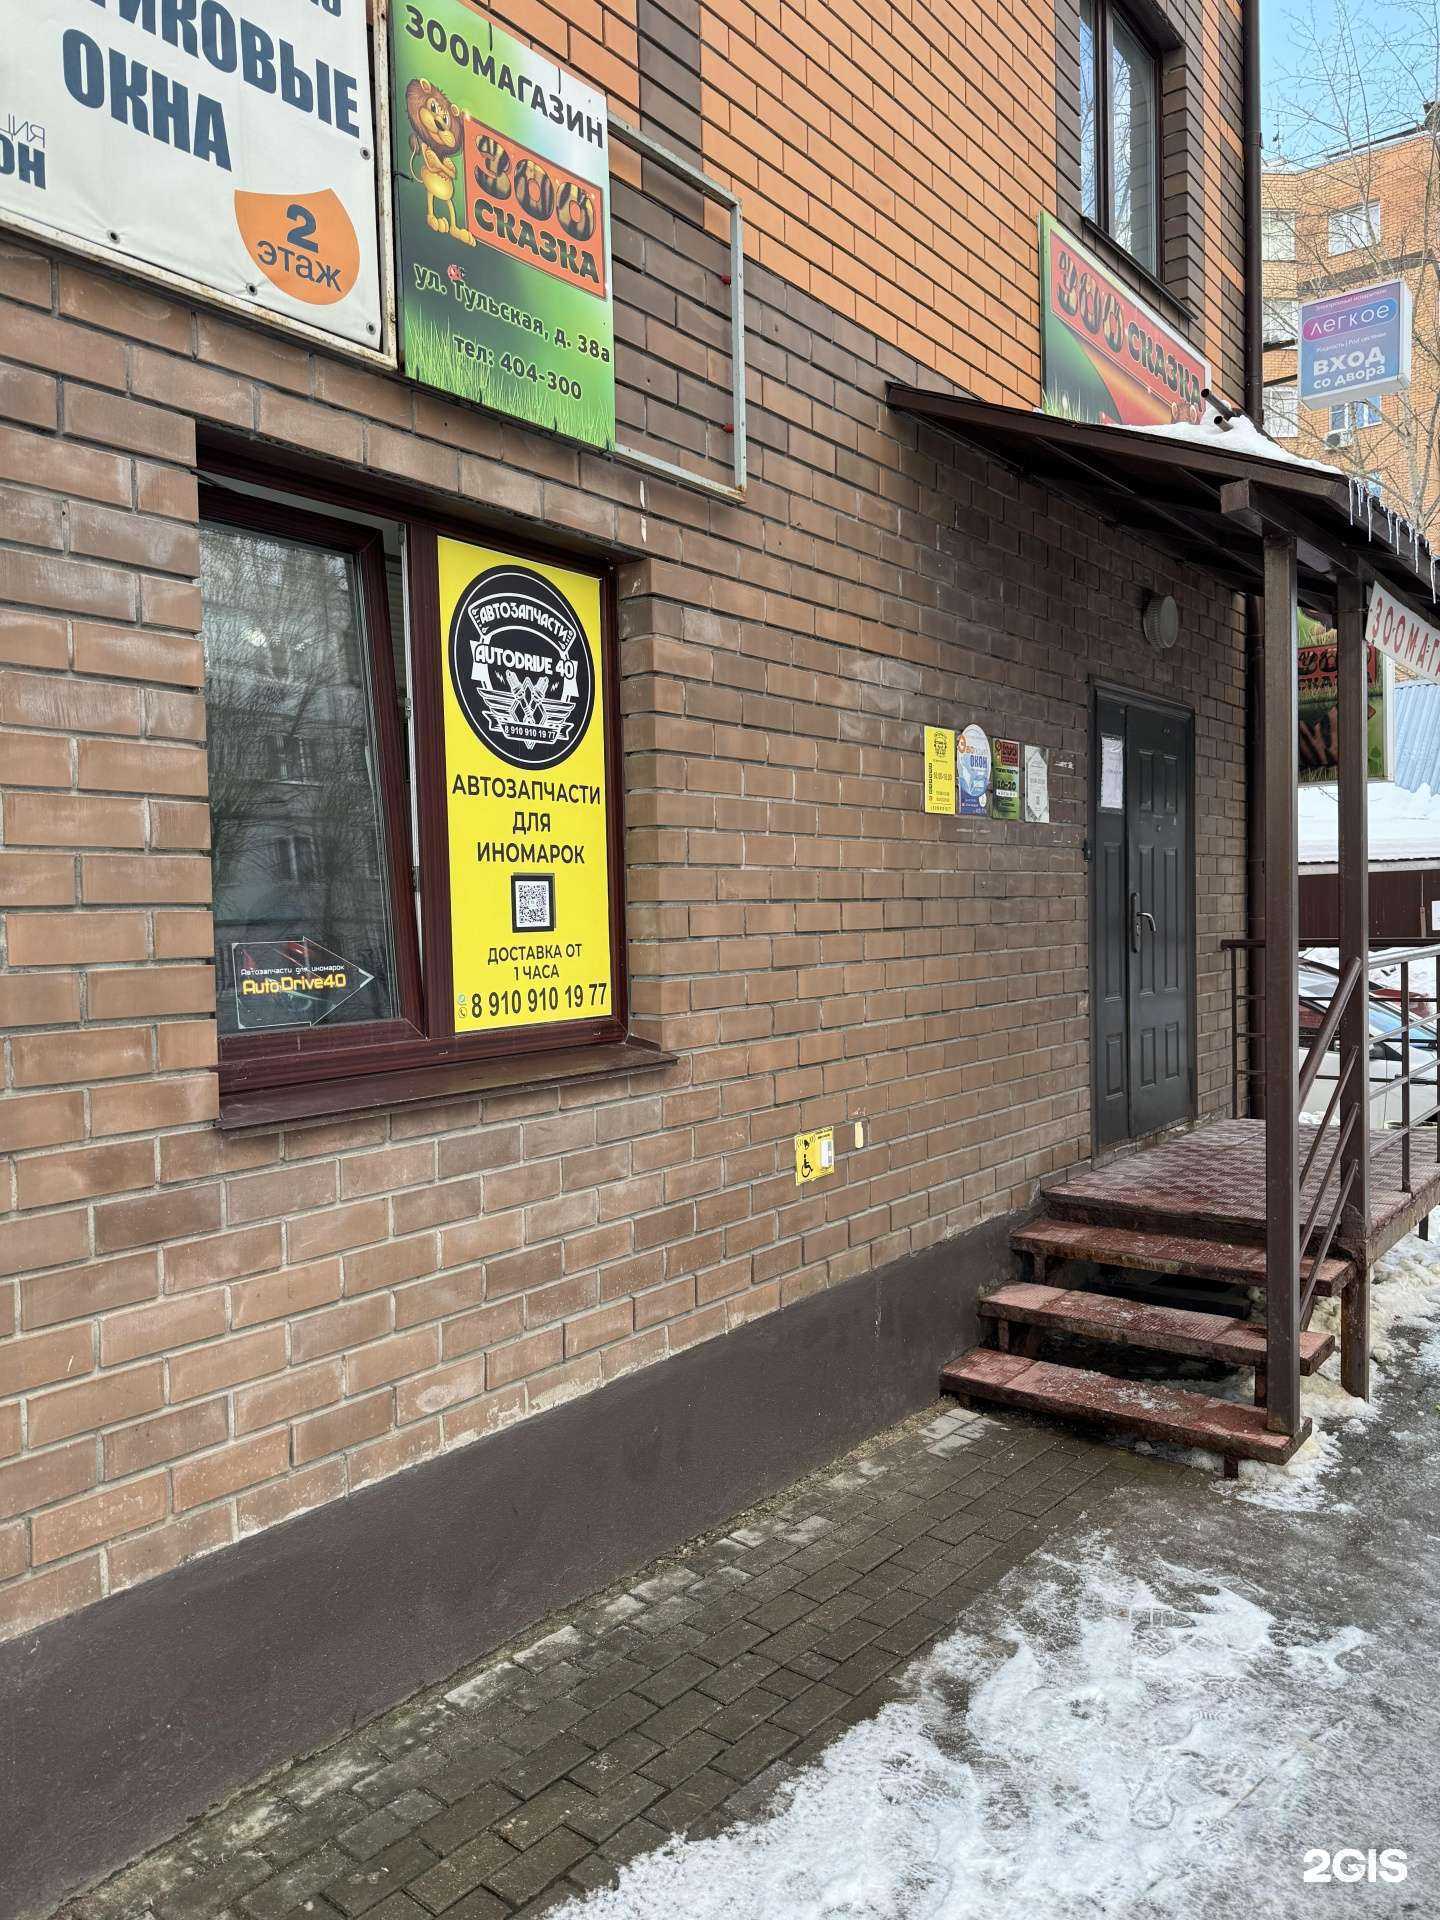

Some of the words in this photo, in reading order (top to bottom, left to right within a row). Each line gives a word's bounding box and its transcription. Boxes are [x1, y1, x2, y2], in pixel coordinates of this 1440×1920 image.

[406, 5, 603, 148] ЗООМАГАЗИН
[63, 29, 232, 172] ОКНА
[474, 134, 596, 241] ЗОО
[286, 204, 319, 252] 2
[474, 199, 600, 284] СКАЗКА
[258, 240, 342, 292] этаж
[414, 264, 447, 295] ул.
[451, 280, 548, 341] Тульская,
[555, 328, 572, 349] д.
[577, 334, 610, 363] 38а
[1057, 251, 1124, 353] ЗОО
[1127, 321, 1202, 404] СКАЗКА
[453, 335, 494, 367] тел:
[500, 352, 582, 400] 404-300
[1313, 346, 1386, 376] ВХОД
[1313, 378, 1331, 389] со
[1335, 365, 1386, 387] двора
[479, 602, 568, 642] АВТОЗАПЧАСТИ
[1372, 597, 1440, 677] ЗООМАГ
[475, 645, 553, 675] AUTODRIVE
[556, 659, 575, 679] 40
[504, 725, 510, 734] 8
[511, 726, 523, 736] 910
[524, 727, 537, 737] 910
[538, 729, 547, 738] 19
[452, 774, 601, 804] АВТОЗАПЧАСТИ
[512, 811, 551, 835] ДЛЯ
[477, 842, 585, 864] ИНОМАРОК
[240, 967, 293, 976] Автозапчасти
[487, 946, 562, 965] ДОСТАВКА
[566, 944, 582, 957] ОТ
[514, 966, 519, 981] 1
[523, 964, 560, 980] ЧАСА
[242, 974, 346, 995] AutoDrive40
[471, 993, 483, 1018] 8
[489, 989, 522, 1016] 910
[528, 986, 559, 1013] 910
[565, 984, 584, 1009] 19
[588, 982, 607, 1006] 77
